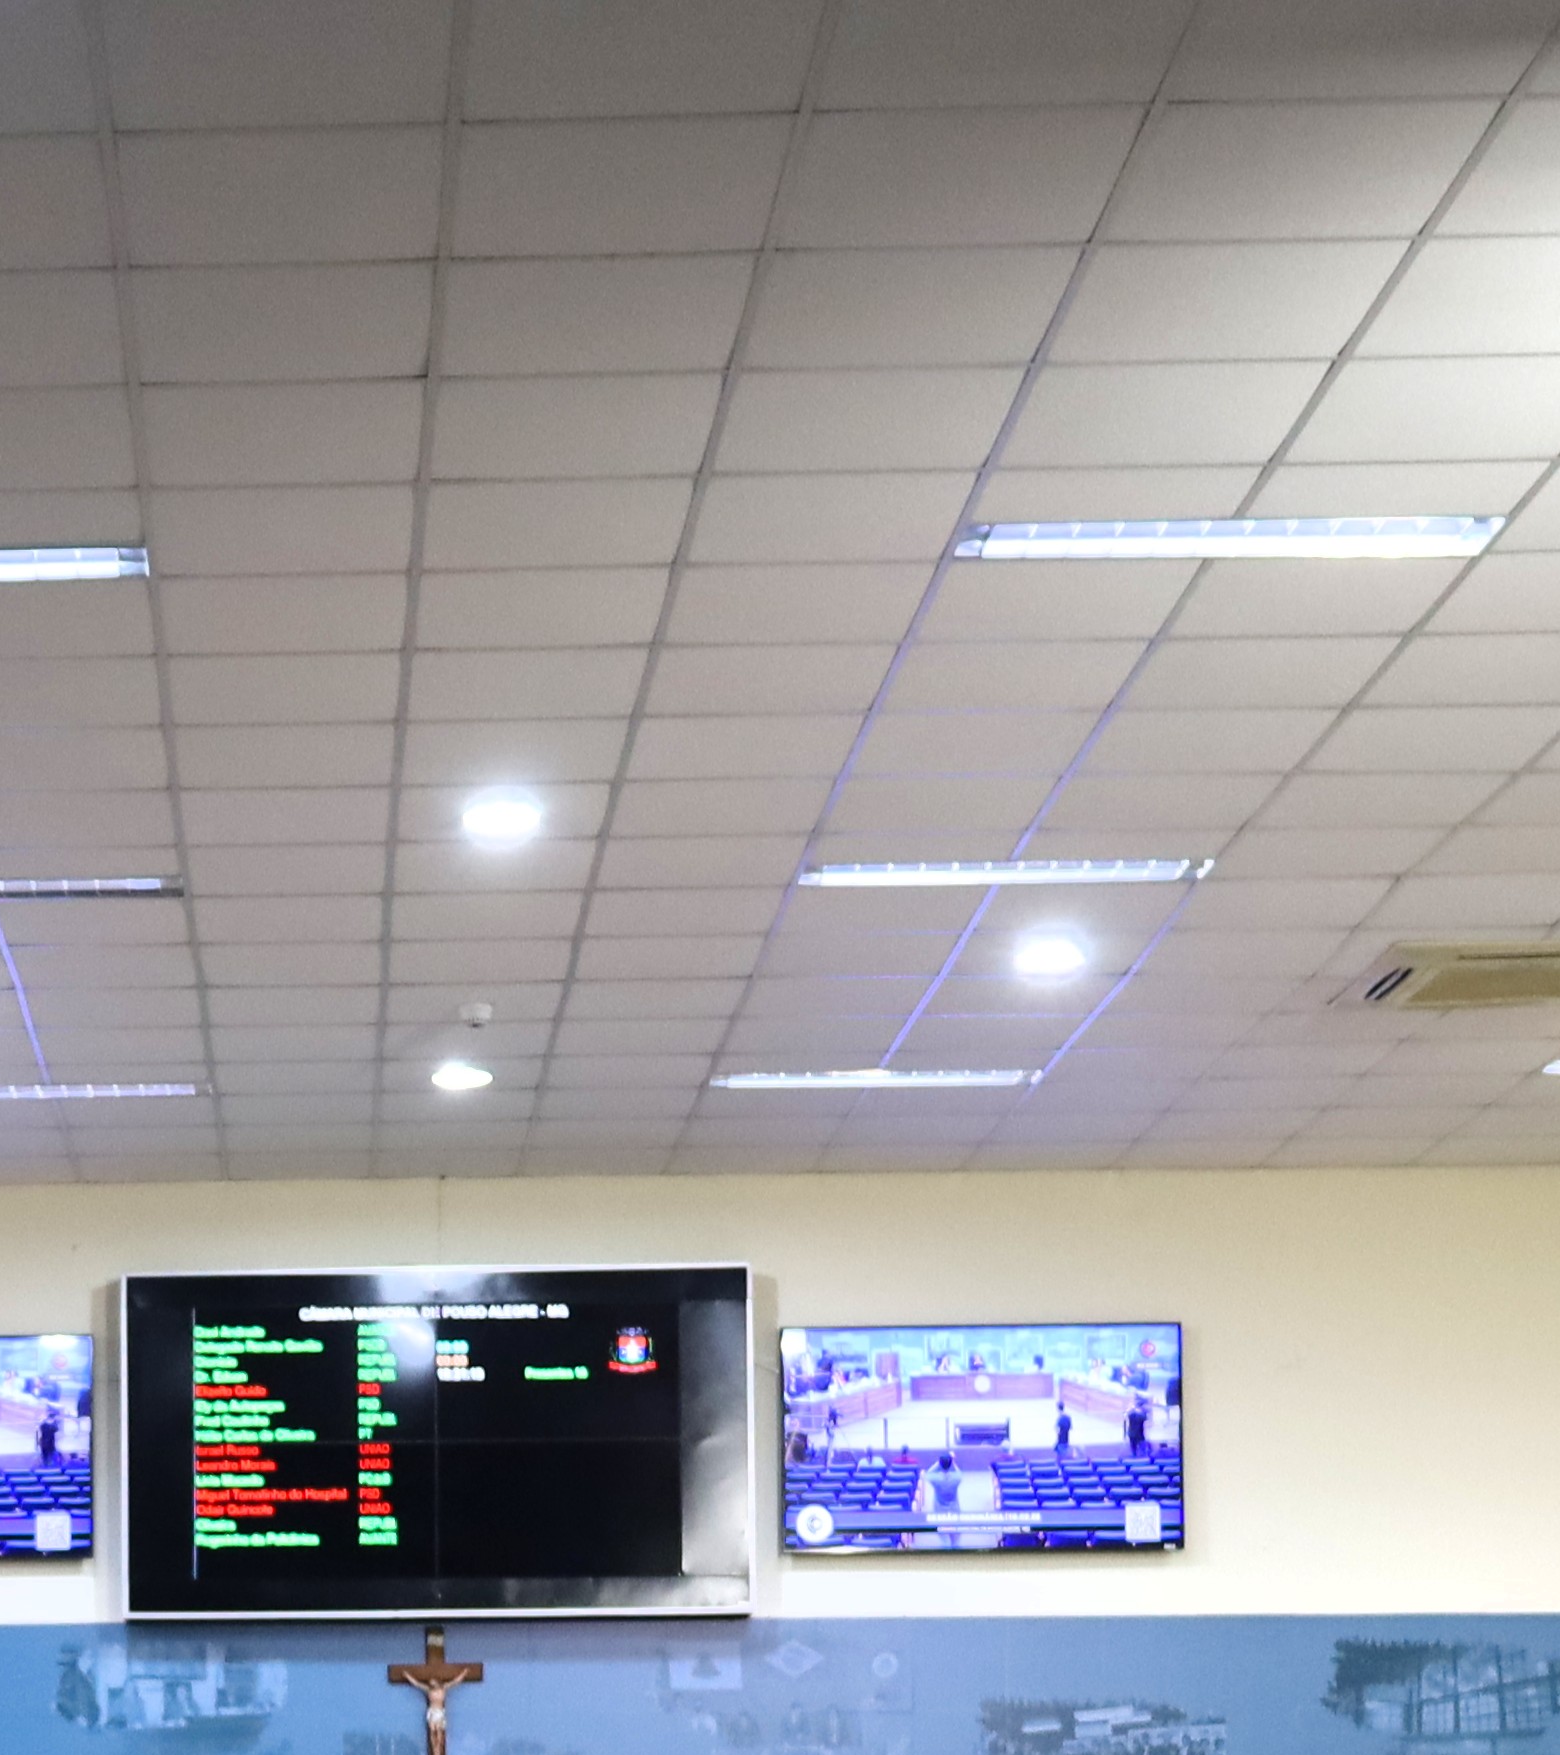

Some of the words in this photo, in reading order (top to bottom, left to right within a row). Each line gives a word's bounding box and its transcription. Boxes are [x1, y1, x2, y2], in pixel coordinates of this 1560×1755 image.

[358, 1383, 381, 1396] PSD
[226, 1444, 260, 1457] Russo
[196, 1460, 238, 1472] Leandro
[240, 1459, 276, 1472] Morais
